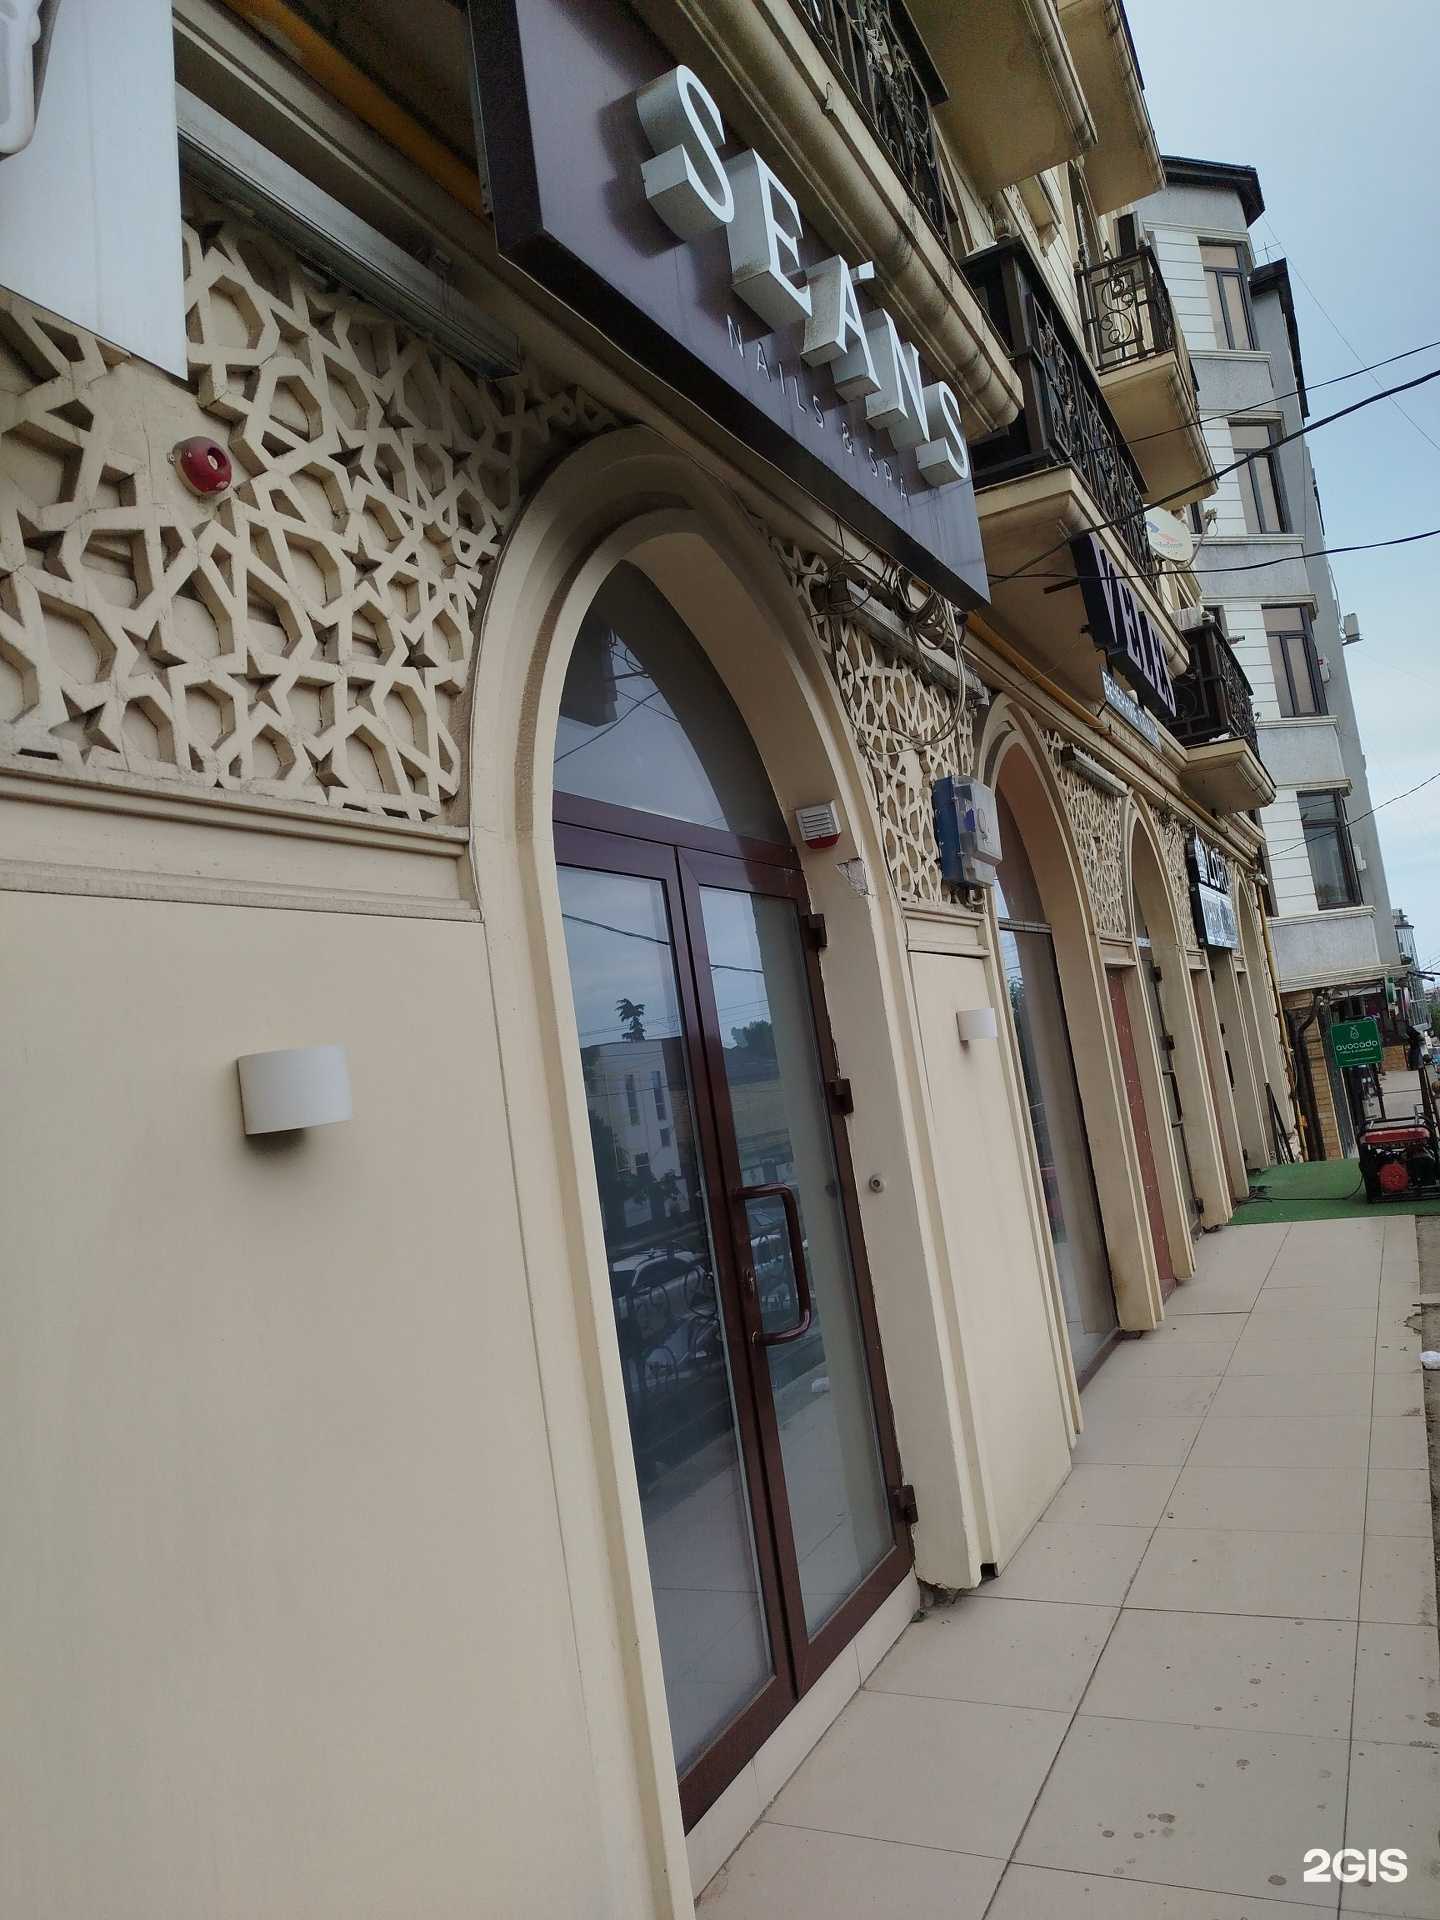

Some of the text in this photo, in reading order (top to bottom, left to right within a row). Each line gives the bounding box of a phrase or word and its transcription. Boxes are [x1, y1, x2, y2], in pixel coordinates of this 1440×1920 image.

[726, 313, 825, 429] NAILS
[868, 447, 910, 506] SPA
[1336, 1040, 1378, 1051] avocado
